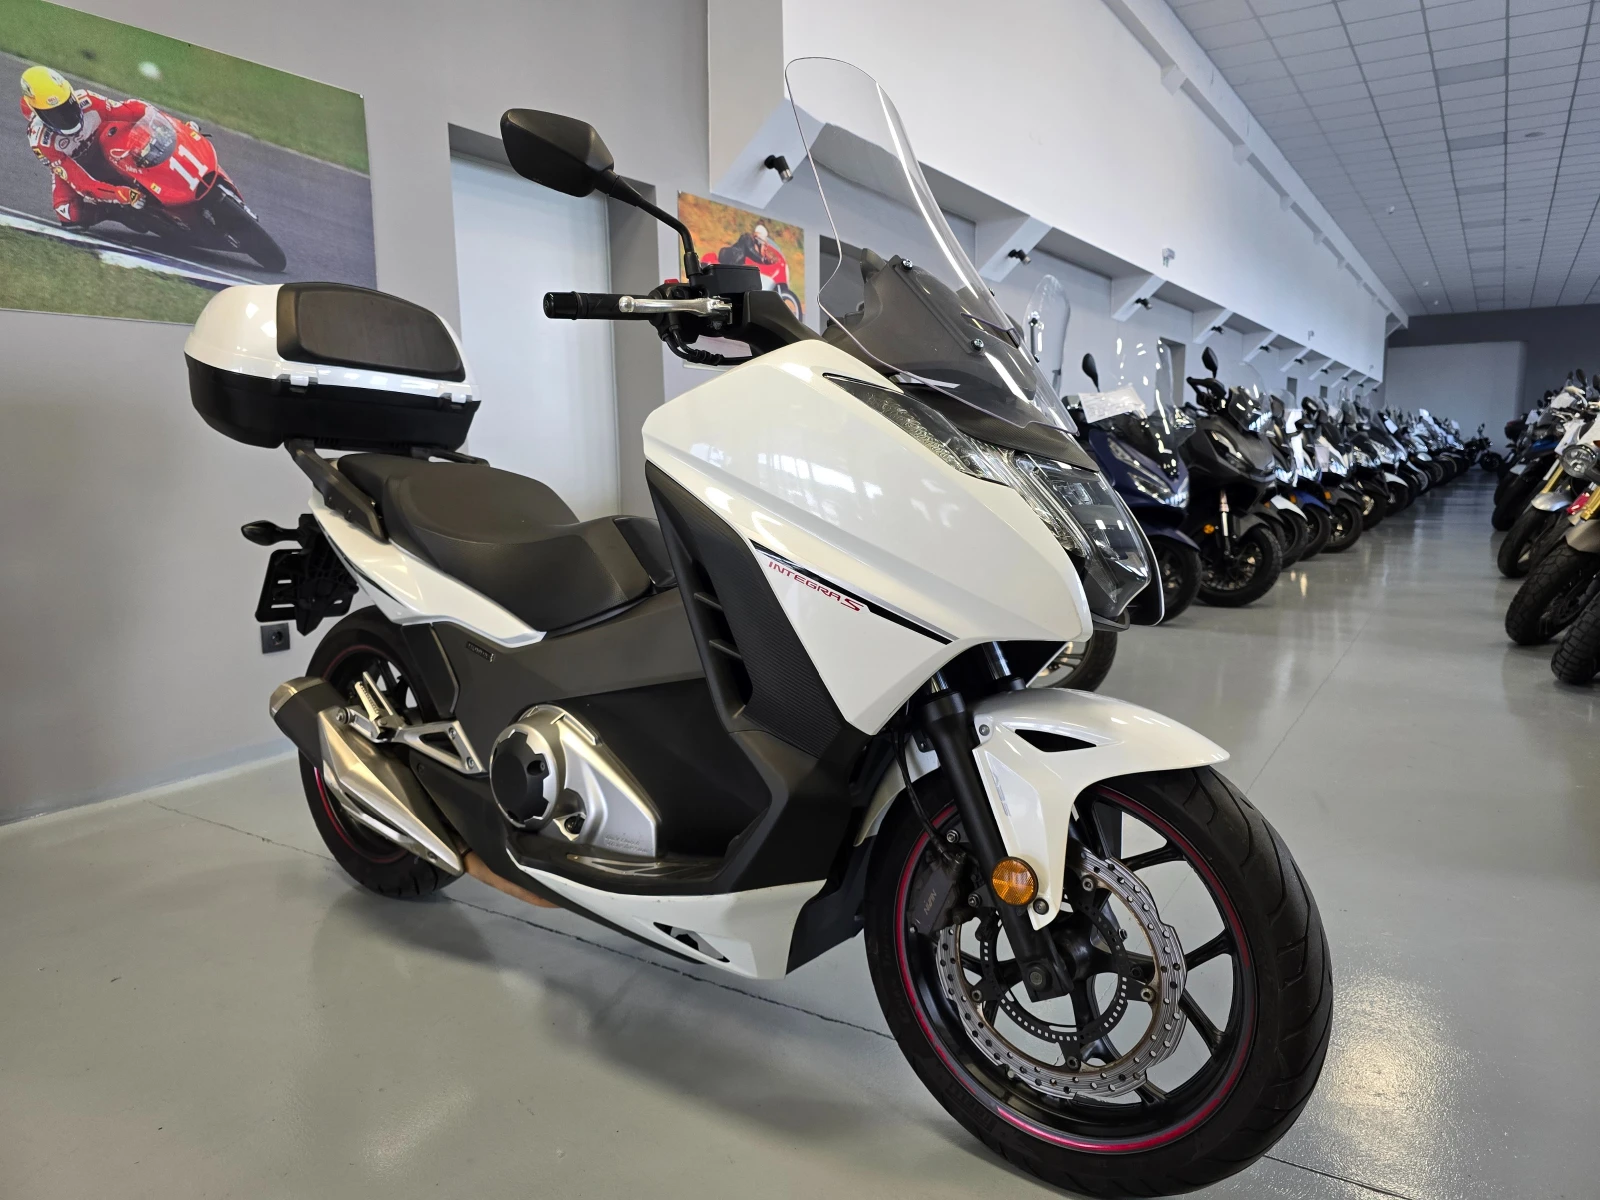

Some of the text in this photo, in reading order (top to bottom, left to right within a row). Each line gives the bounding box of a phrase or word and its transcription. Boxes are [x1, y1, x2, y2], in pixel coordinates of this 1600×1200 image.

[169, 144, 208, 192] 11
[768, 561, 864, 612] INTEGRA S
